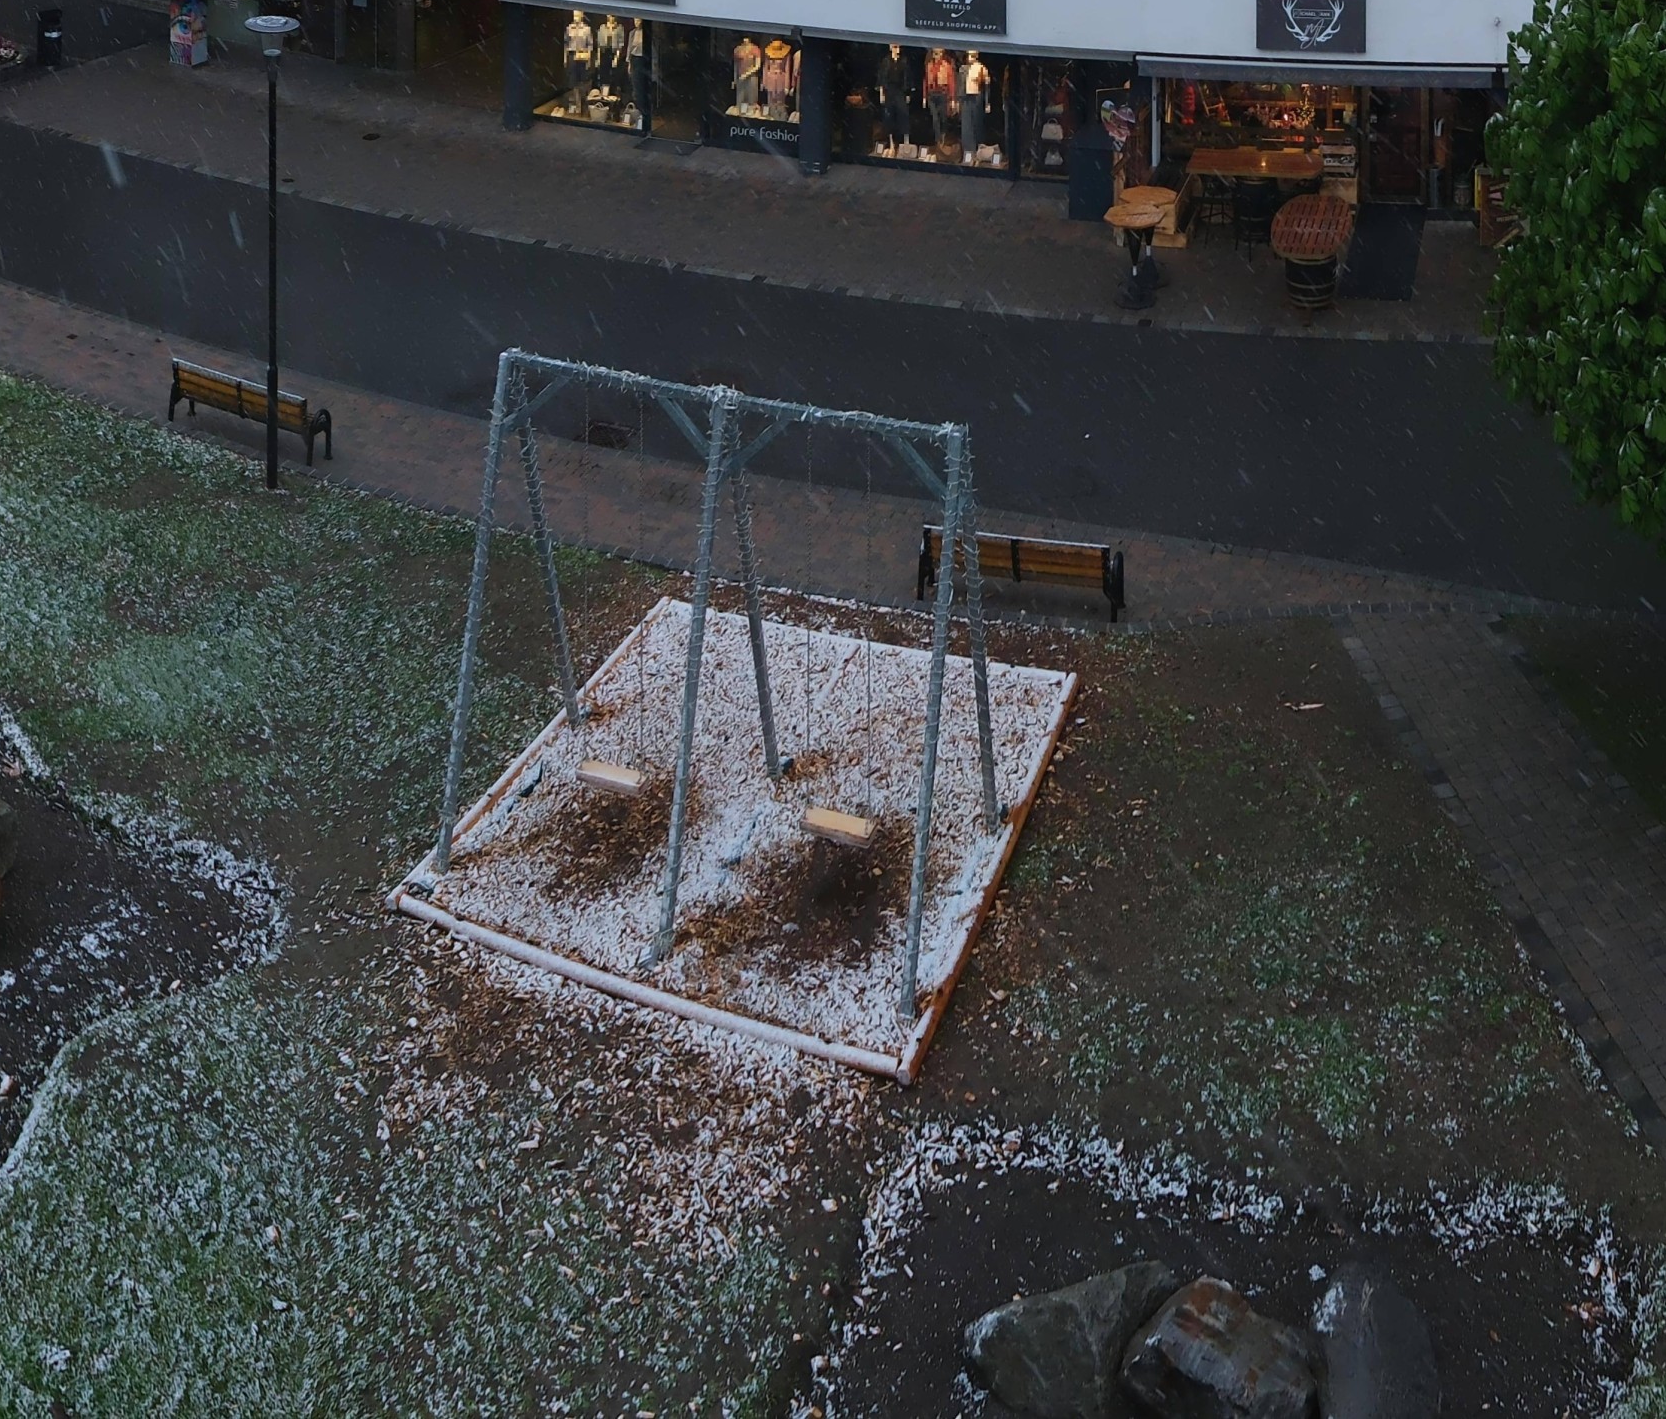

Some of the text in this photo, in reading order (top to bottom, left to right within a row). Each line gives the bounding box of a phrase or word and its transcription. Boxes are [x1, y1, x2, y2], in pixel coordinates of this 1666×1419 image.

[915, 19, 944, 27] SEEFELD
[946, 21, 981, 29] SHOPPING
[730, 125, 756, 137] pure
